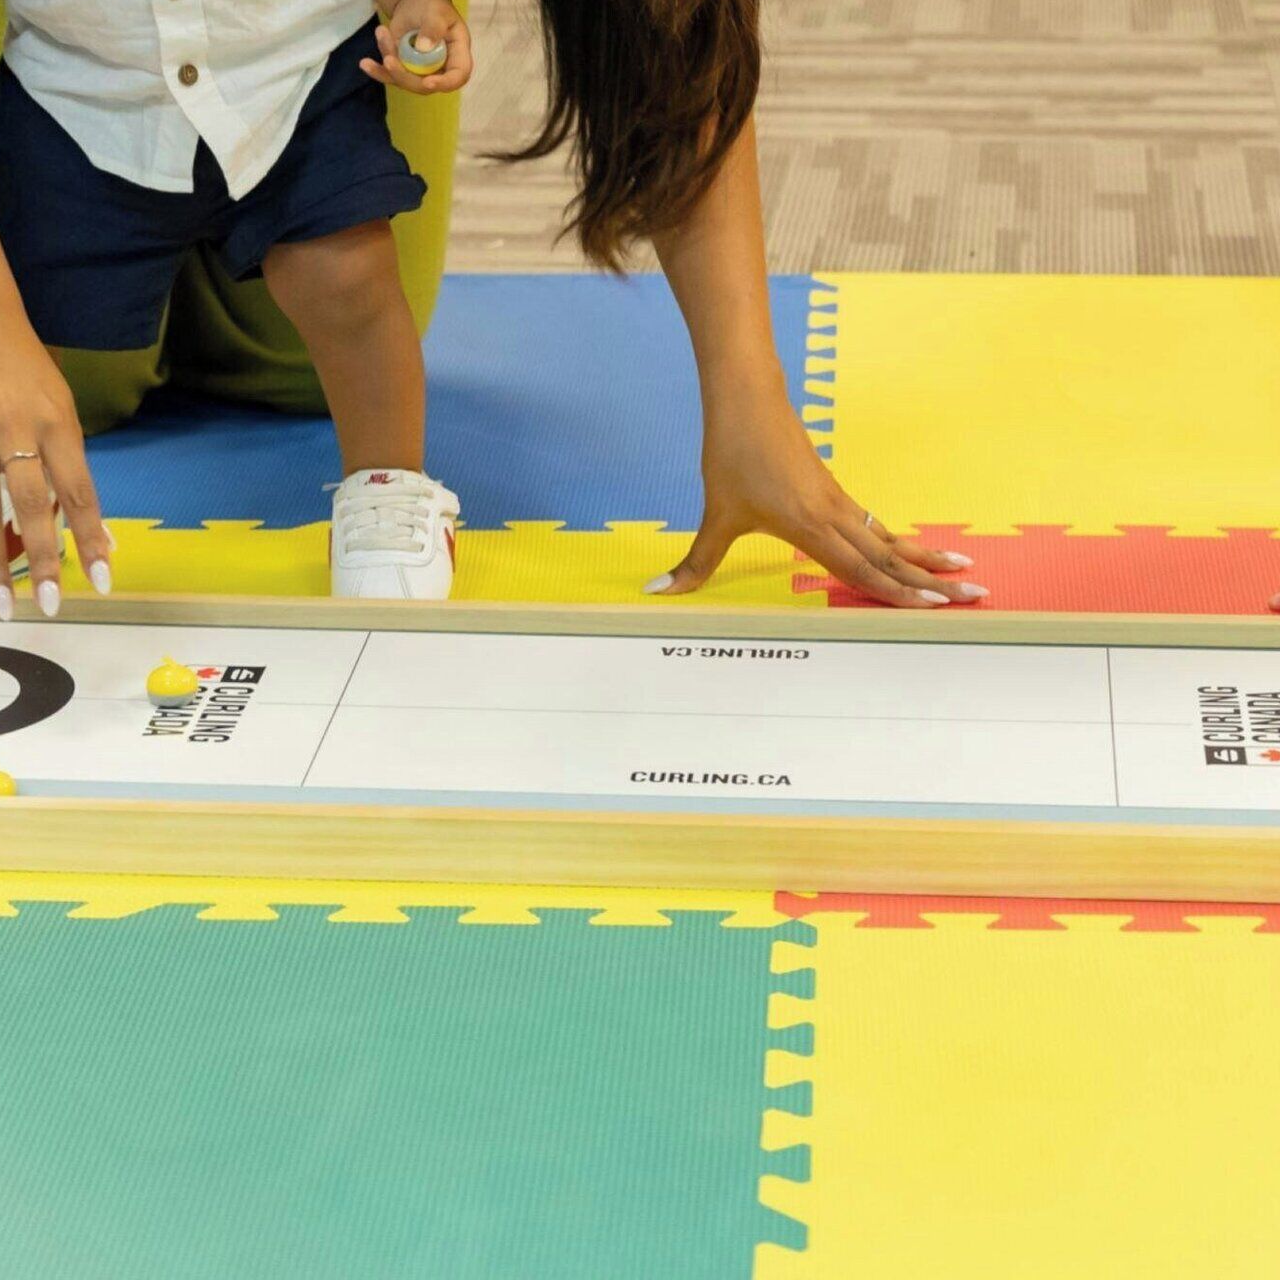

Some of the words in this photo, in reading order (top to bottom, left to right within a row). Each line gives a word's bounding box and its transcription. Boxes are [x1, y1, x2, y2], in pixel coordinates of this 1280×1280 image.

[661, 646, 810, 660] CURLING.CA
[141, 685, 208, 737] NADA
[188, 685, 255, 743] CURLING
[1196, 685, 1246, 743] CURLING
[629, 770, 792, 786] CURLING.CA
